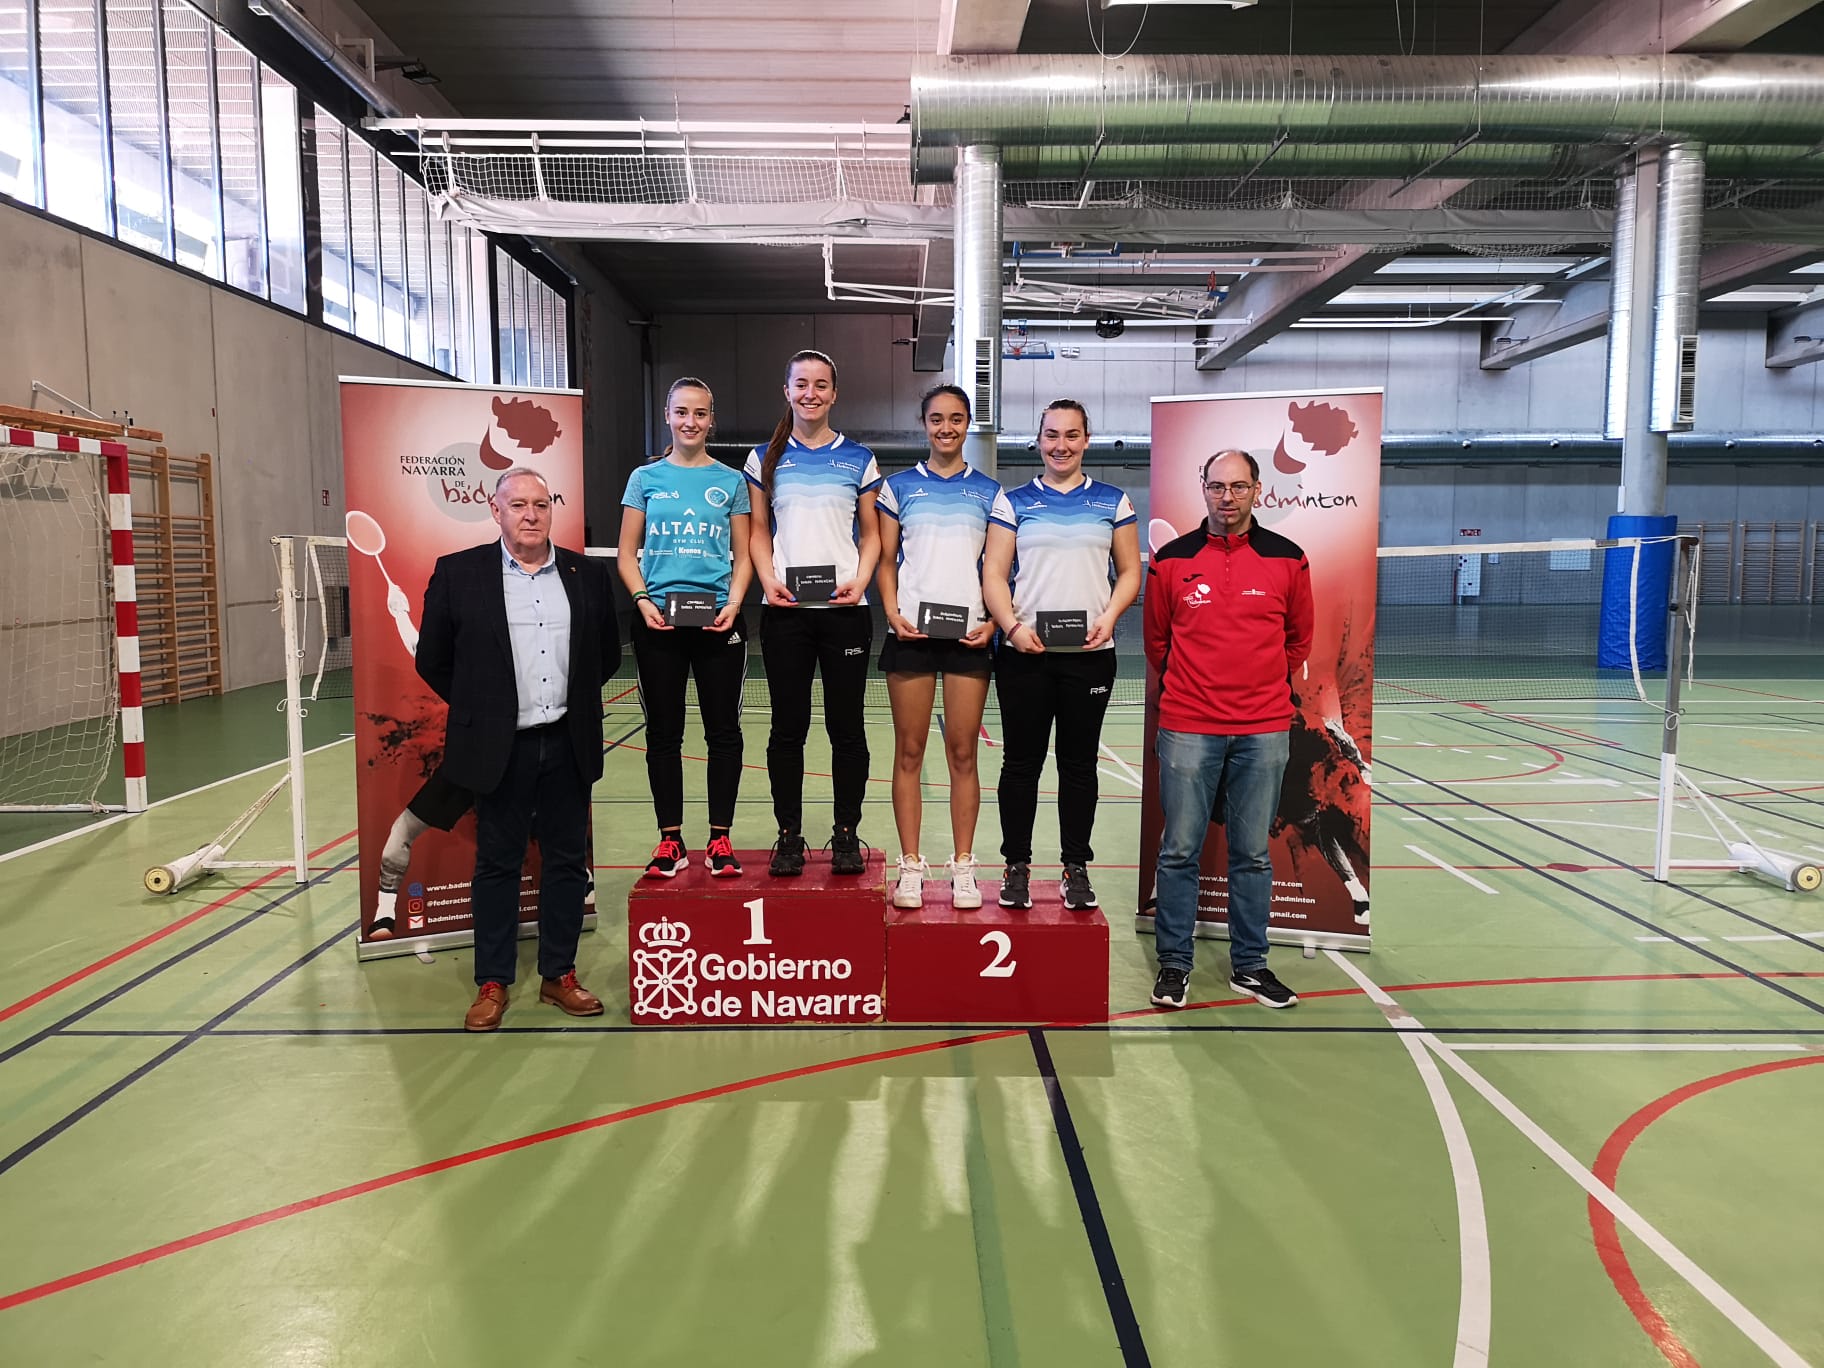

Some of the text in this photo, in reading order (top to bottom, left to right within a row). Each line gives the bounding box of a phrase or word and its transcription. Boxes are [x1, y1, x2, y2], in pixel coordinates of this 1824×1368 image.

[400, 455, 465, 466] FEDERACIÓN
[402, 465, 466, 477] NAVARRA
[649, 521, 723, 539] ALTAFIT
[743, 897, 773, 945] 1
[700, 953, 852, 981] Gobierno
[979, 930, 1018, 978] 2
[701, 990, 882, 1018] de Navarra
